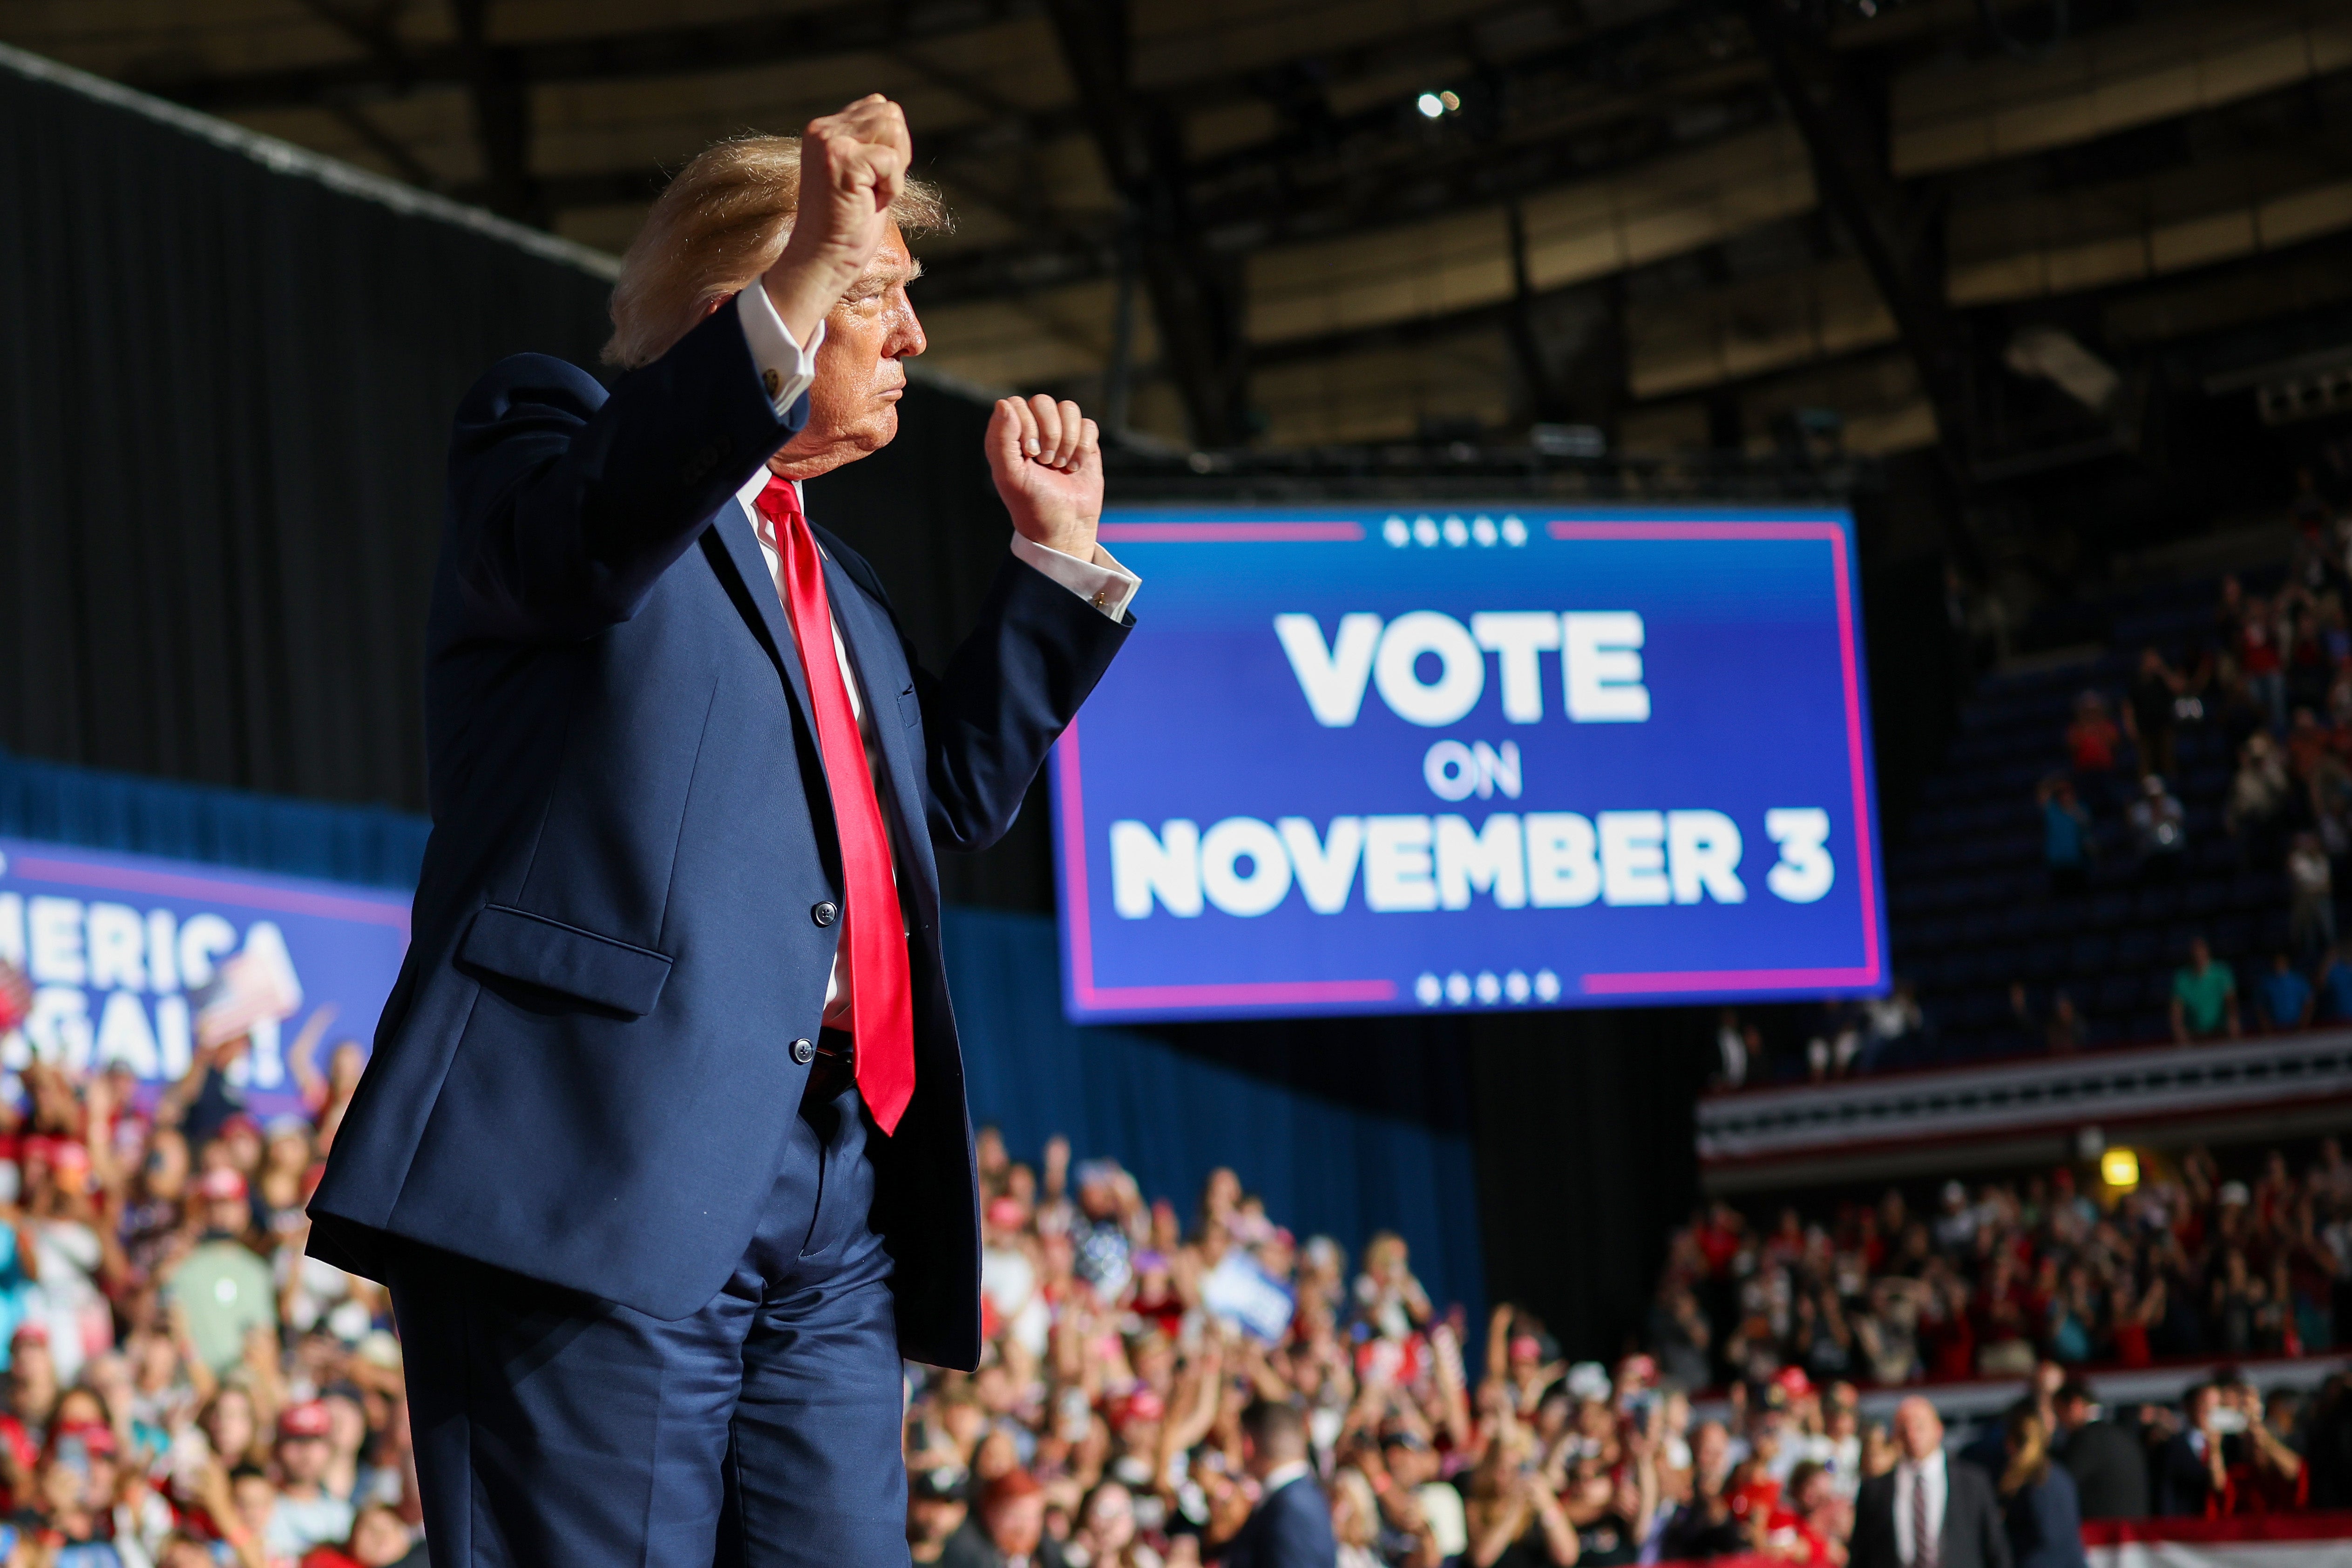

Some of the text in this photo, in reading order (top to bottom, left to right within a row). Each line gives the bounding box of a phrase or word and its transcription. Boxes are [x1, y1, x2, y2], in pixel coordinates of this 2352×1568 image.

[1274, 610, 1651, 726] VOTE
[1423, 740, 1523, 801] ON
[1109, 808, 1835, 919] NOVEMBER 3
